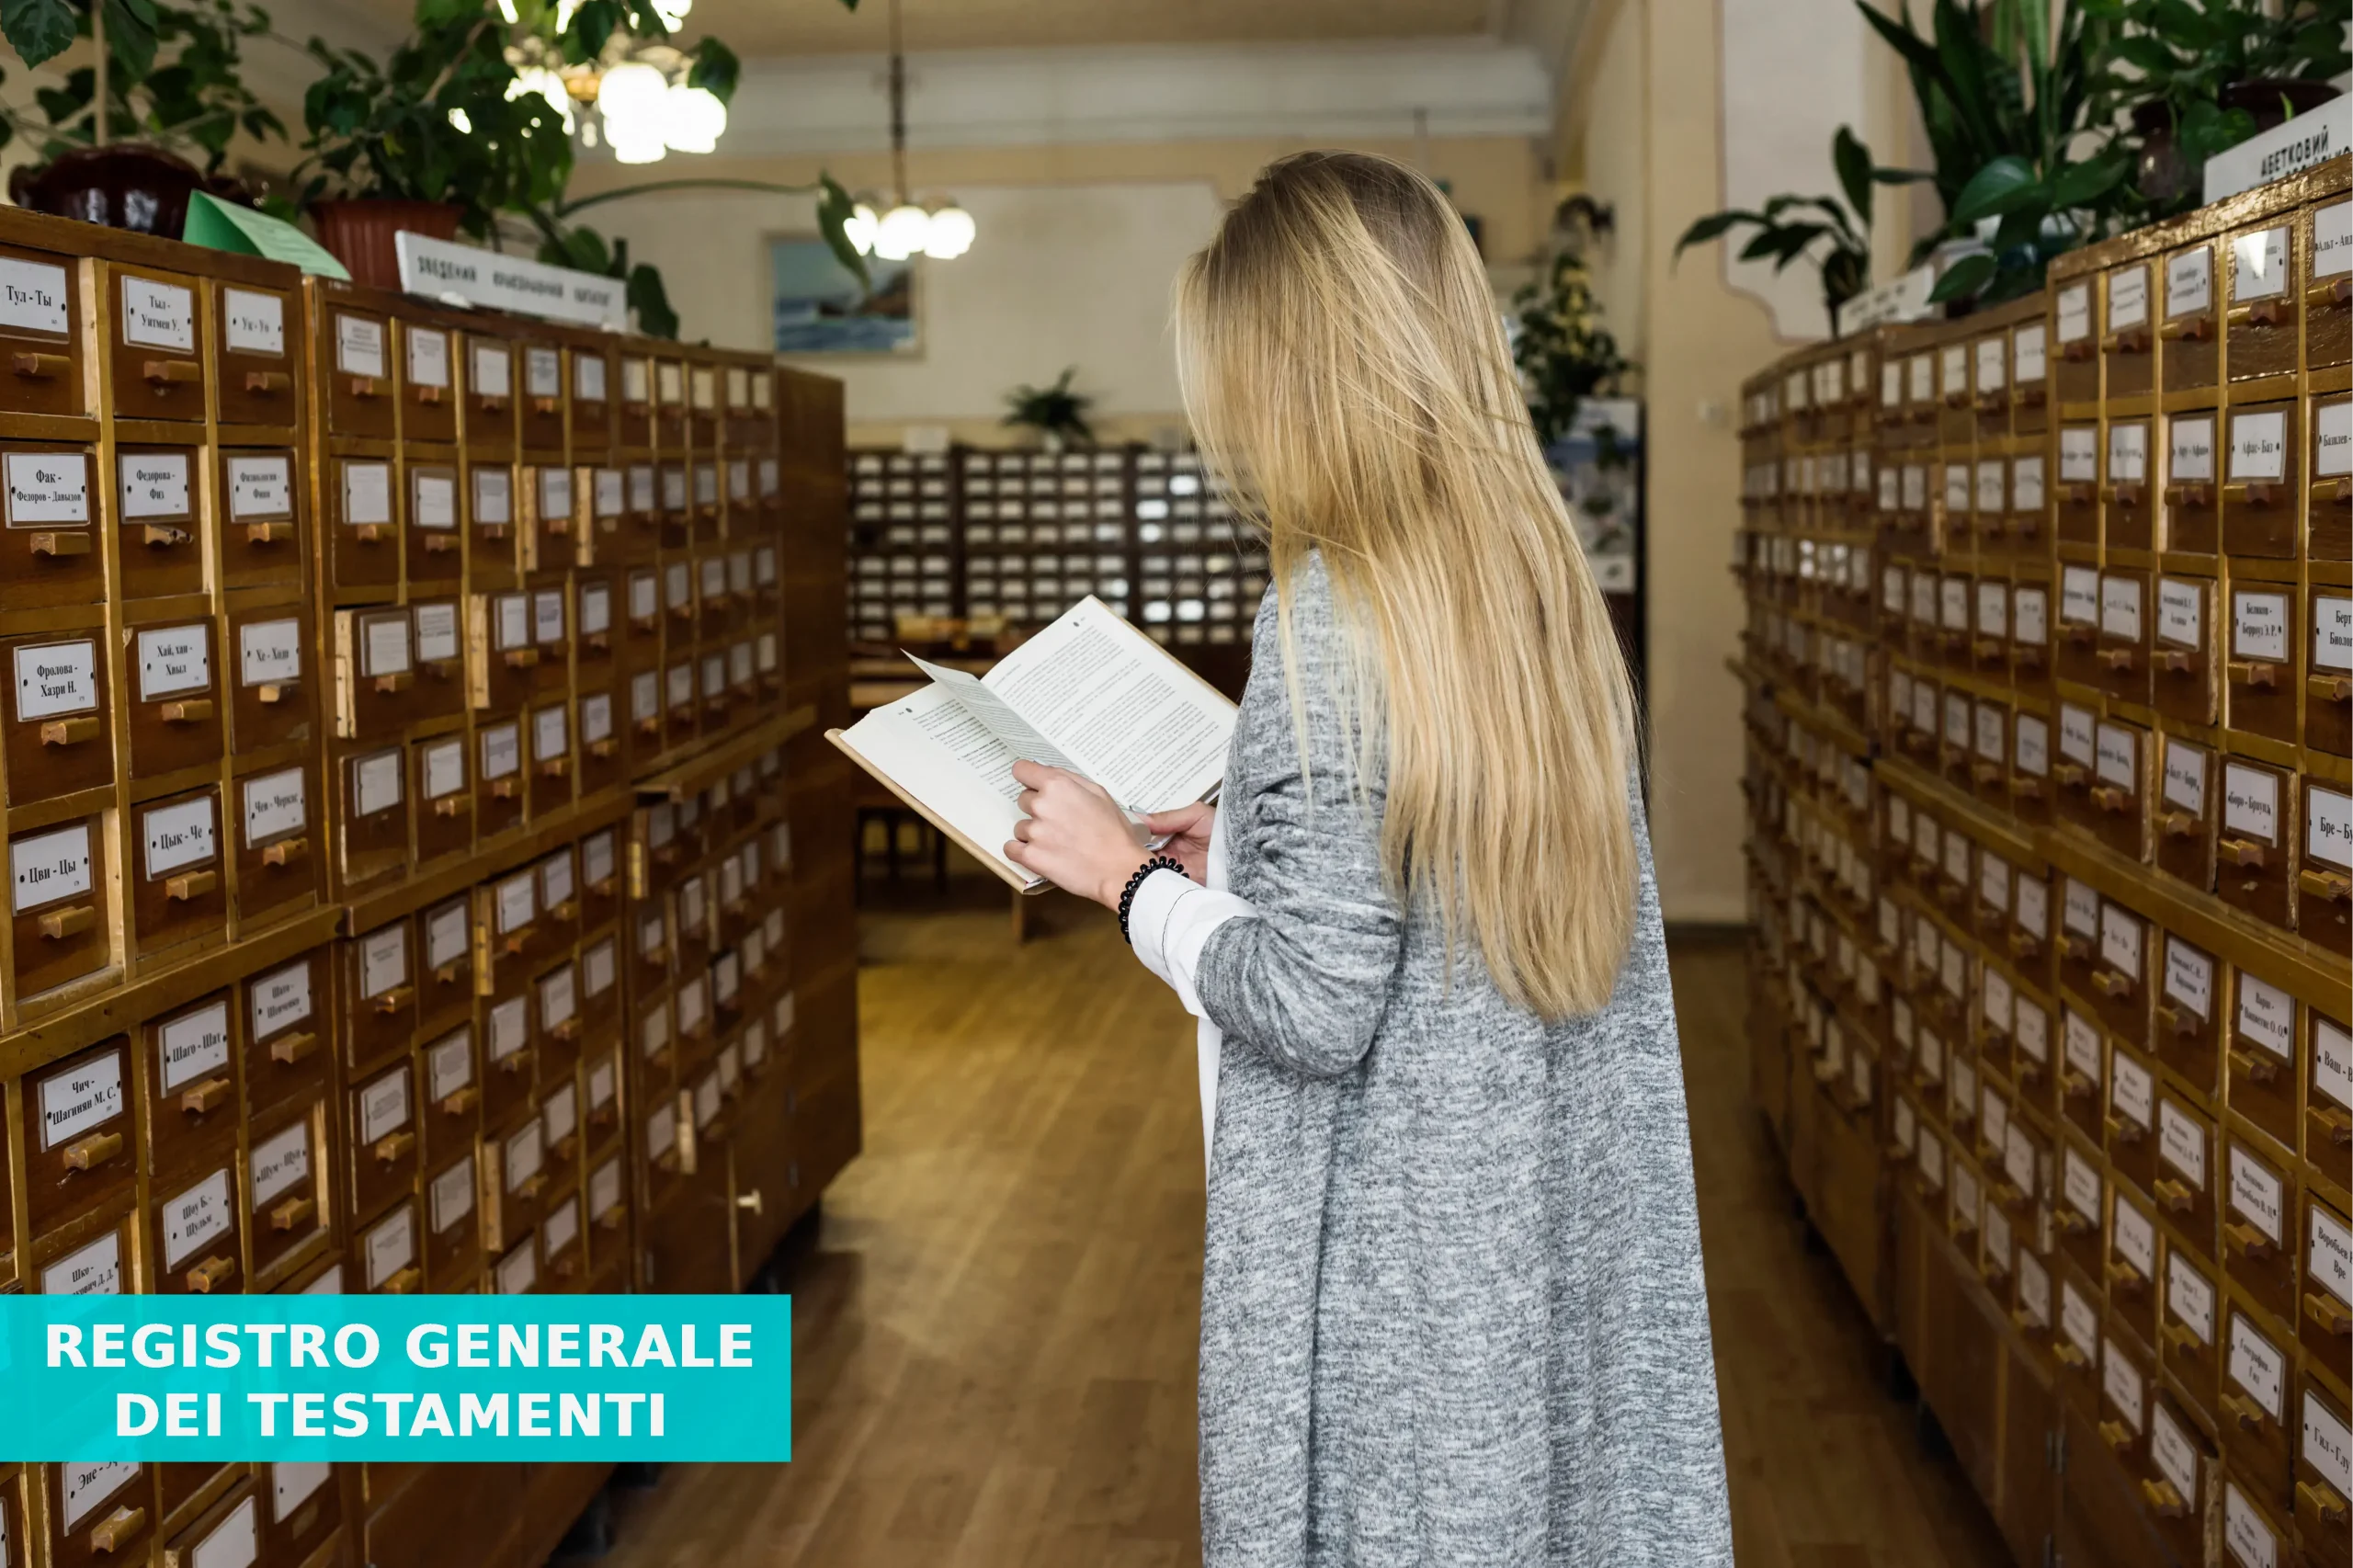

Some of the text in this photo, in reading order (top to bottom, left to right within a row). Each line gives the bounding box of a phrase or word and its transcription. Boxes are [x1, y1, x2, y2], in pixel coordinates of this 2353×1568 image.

[6, 285, 27, 306] Тул
[35, 290, 51, 307] Ты
[149, 295, 165, 310] Тыл
[36, 470, 56, 483] Фак
[136, 470, 171, 484] Федорова
[17, 492, 46, 504] Федоров
[52, 491, 81, 503] Давыдов
[150, 489, 165, 500] Физ
[37, 665, 73, 680] Фролова
[165, 664, 187, 676] Хвыл
[40, 684, 65, 699] Хазри
[67, 681, 76, 694] Н.
[2320, 816, 2336, 837] Бре
[161, 834, 183, 852] Цык
[190, 824, 202, 839] Че
[29, 867, 51, 885] Цви
[59, 858, 76, 878] Цы
[172, 1043, 196, 1062] Шаго
[2325, 1050, 2341, 1075] Ваш
[72, 1080, 90, 1094] Чич
[52, 1099, 93, 1126] Шагинян
[95, 1090, 106, 1107] М.
[107, 1086, 116, 1100] С.
[2318, 1225, 2348, 1260] Воробьев
[72, 1267, 90, 1283] Шко
[2334, 1259, 2347, 1280] Вре
[2313, 1426, 2329, 1452] Гил
[2336, 1446, 2350, 1474] Глу
[78, 1468, 97, 1490] Эне
